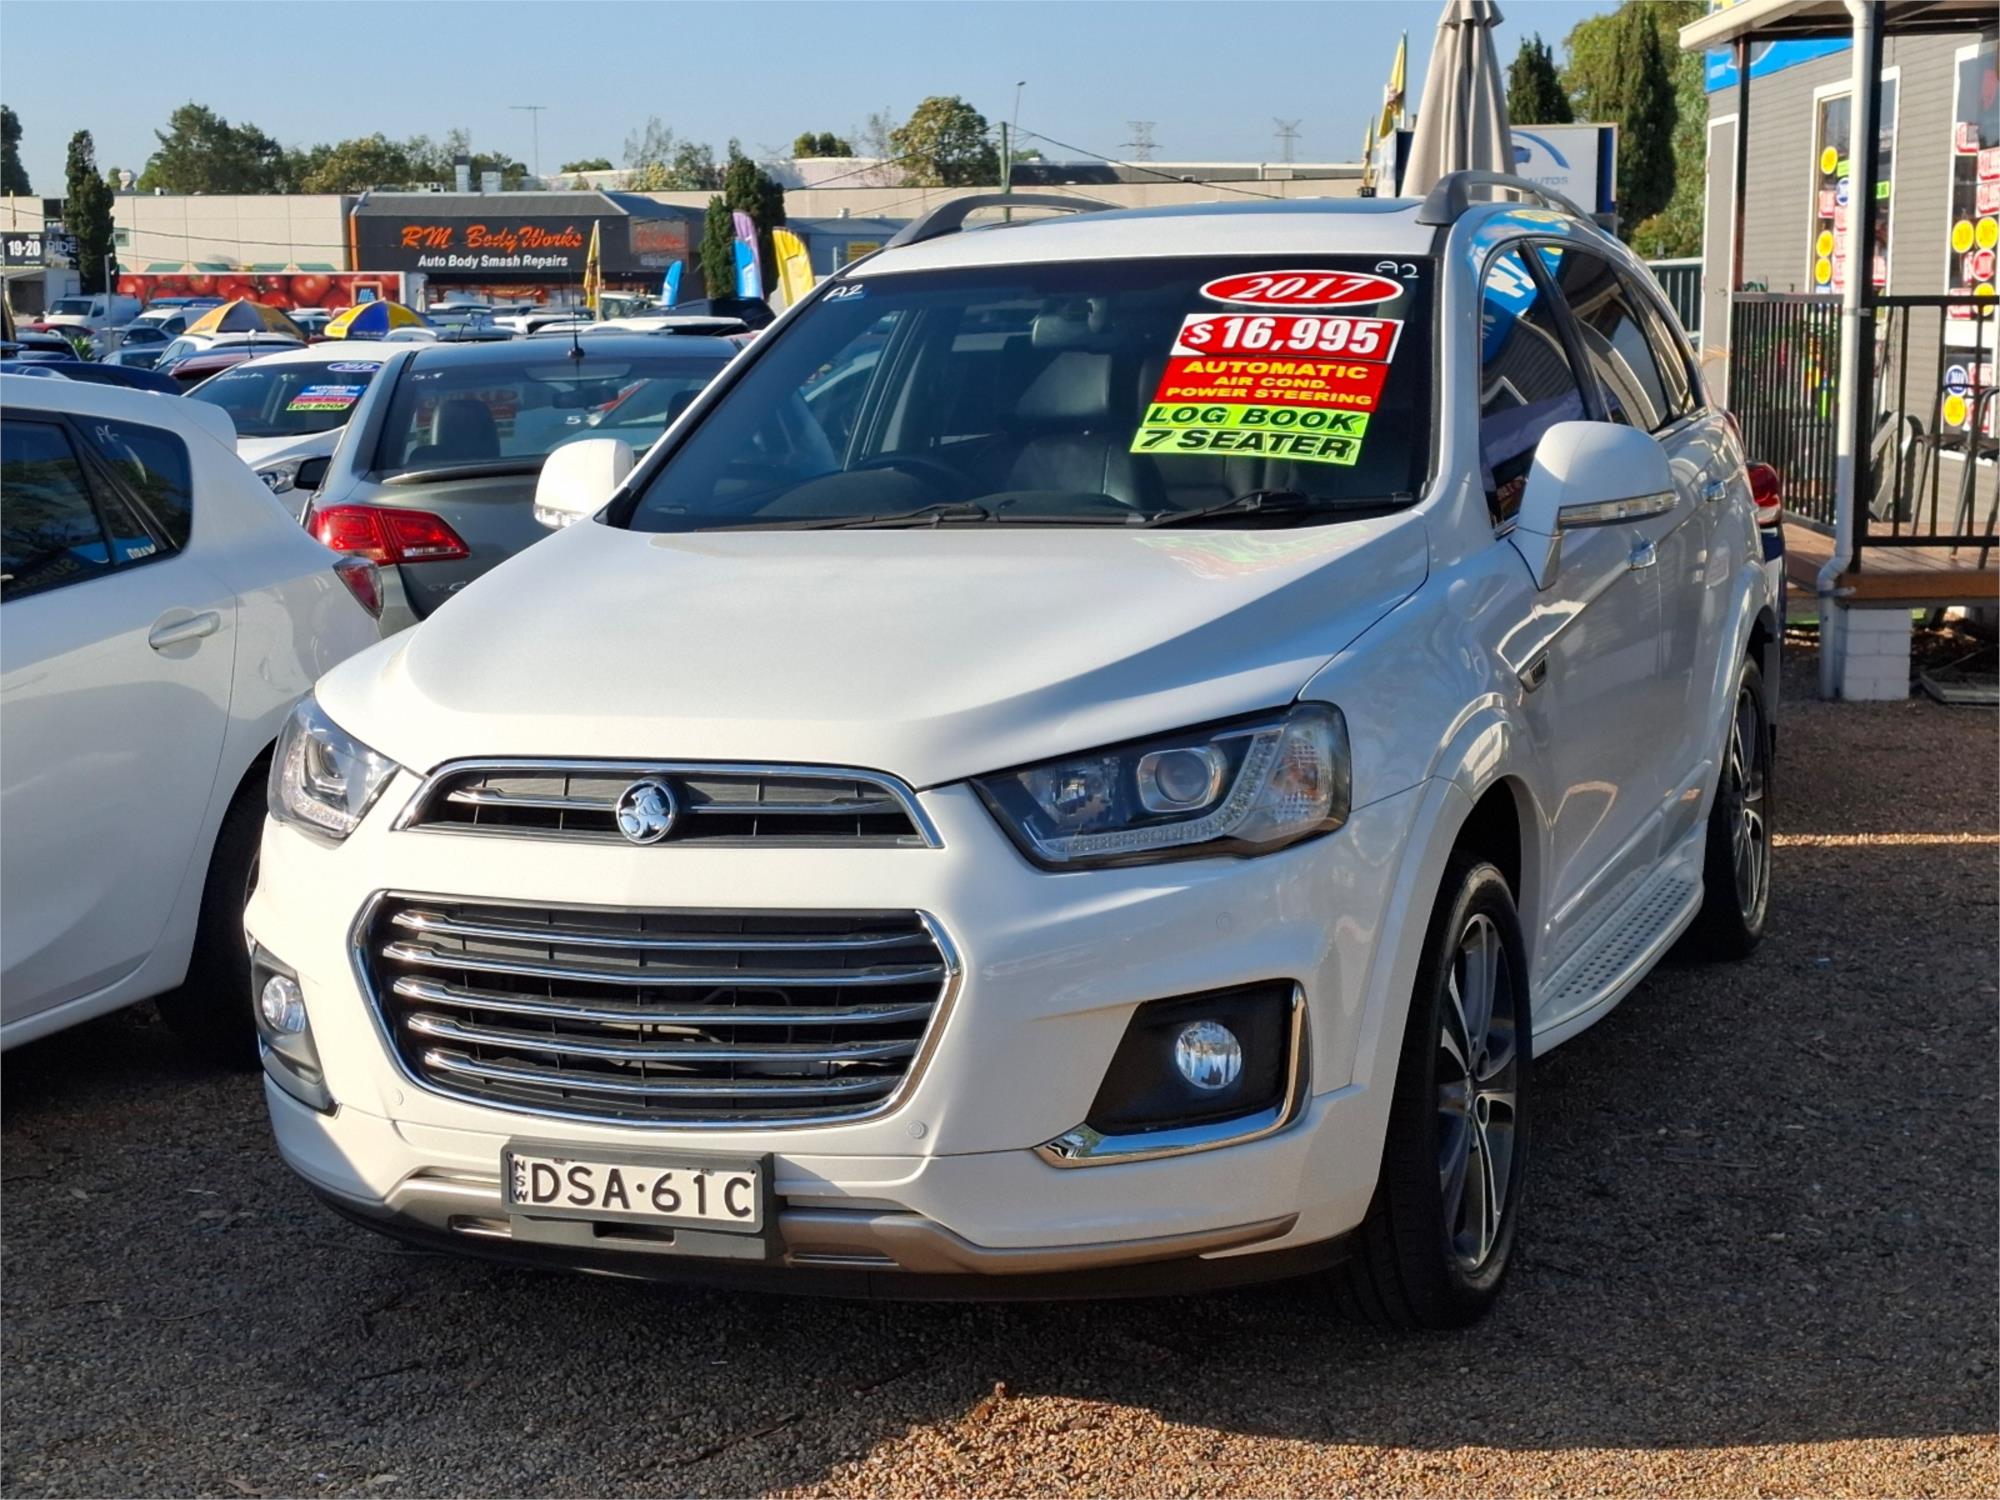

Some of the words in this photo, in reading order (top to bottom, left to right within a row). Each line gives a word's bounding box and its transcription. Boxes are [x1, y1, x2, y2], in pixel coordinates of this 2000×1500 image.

[401, 224, 453, 249] RM
[417, 254, 446, 268] Auto
[448, 254, 479, 270] Body
[480, 254, 520, 268] Smash
[522, 254, 568, 270] Repairs
[822, 283, 864, 302] A2
[1228, 276, 1378, 299] 2017
[1183, 360, 1369, 380] AUTOMATIC
[1213, 375, 1254, 387] AIR
[1260, 377, 1332, 390] COND.
[1165, 386, 1248, 399] POWER
[1253, 388, 1373, 406] STEERING
[1146, 406, 1230, 427] LOG
[1237, 408, 1364, 434] BOOK
[1139, 429, 1175, 450] 7
[1175, 429, 1356, 459] SEATER
[513, 1159, 529, 1203] NSW
